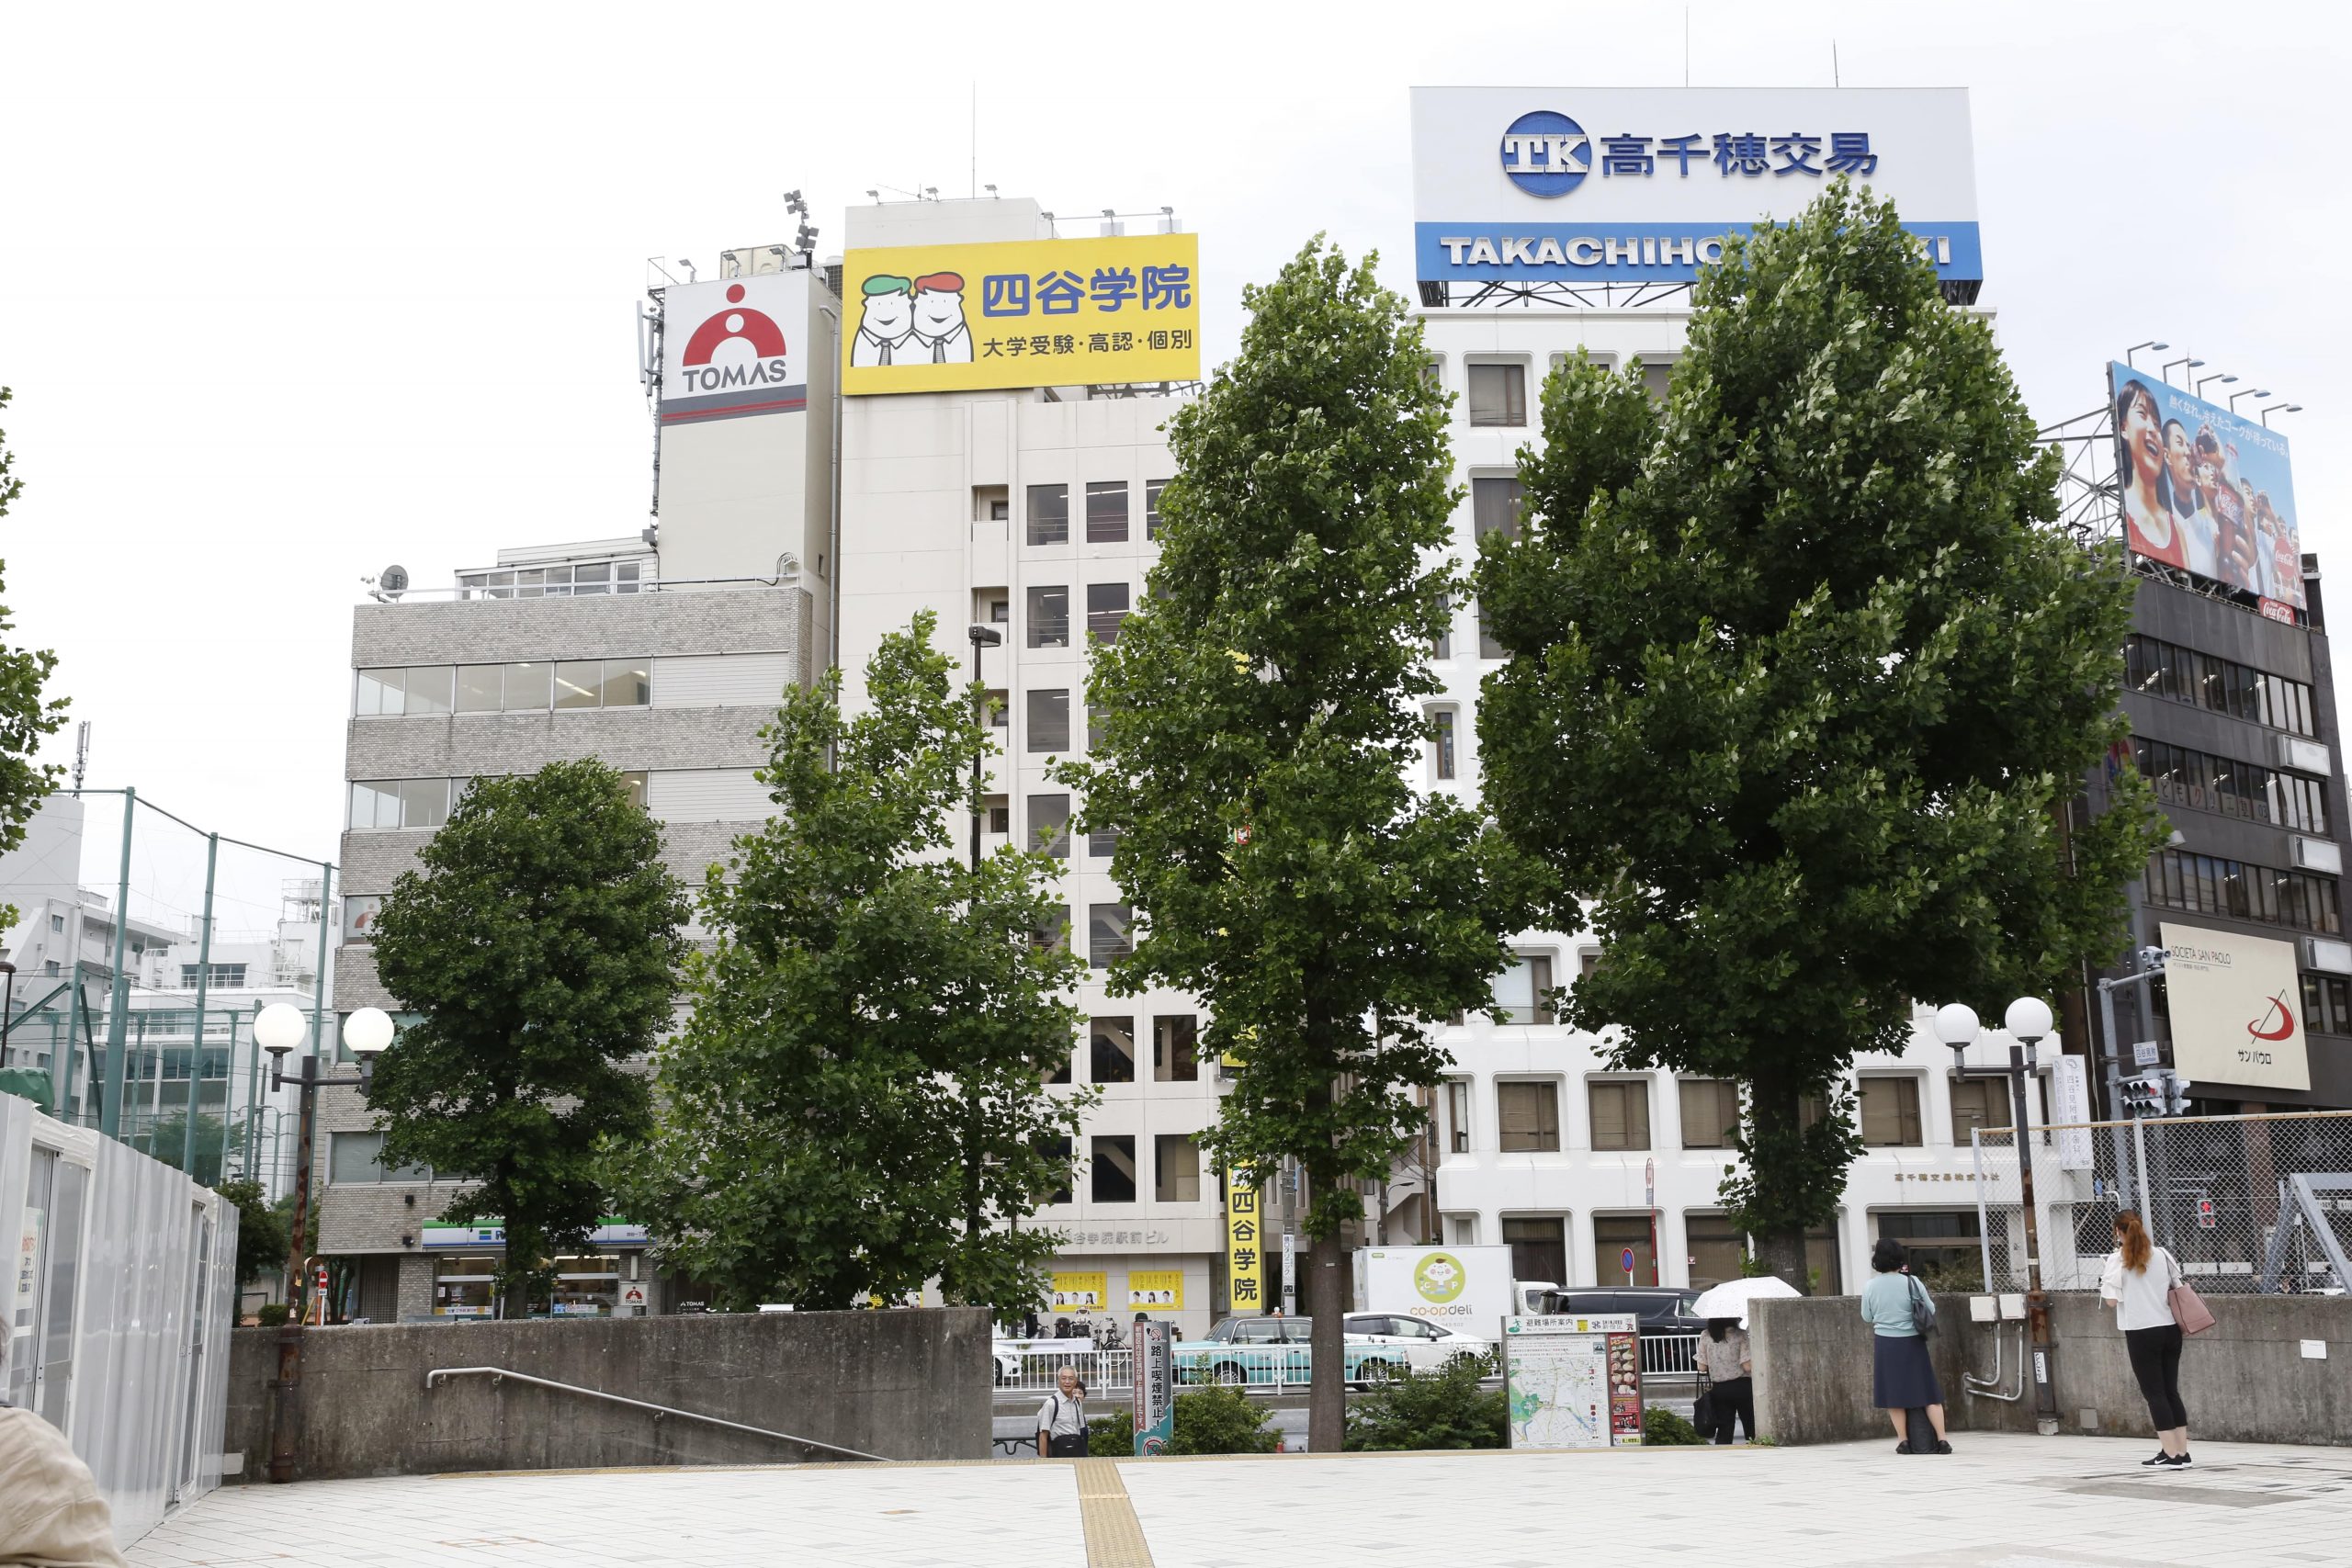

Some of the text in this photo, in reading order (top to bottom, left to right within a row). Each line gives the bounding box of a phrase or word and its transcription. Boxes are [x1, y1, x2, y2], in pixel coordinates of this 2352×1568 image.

[1504, 133, 1589, 174] TK
[1600, 131, 1879, 177] 高千穂交易
[1440, 236, 1724, 266] TAKACHIHO
[982, 264, 1192, 318] 四谷学院
[682, 359, 786, 392] TOMAS
[2198, 949, 2210, 962] SAN
[2211, 951, 2232, 964] PAOLO
[1233, 1191, 1258, 1301] 四谷学院
